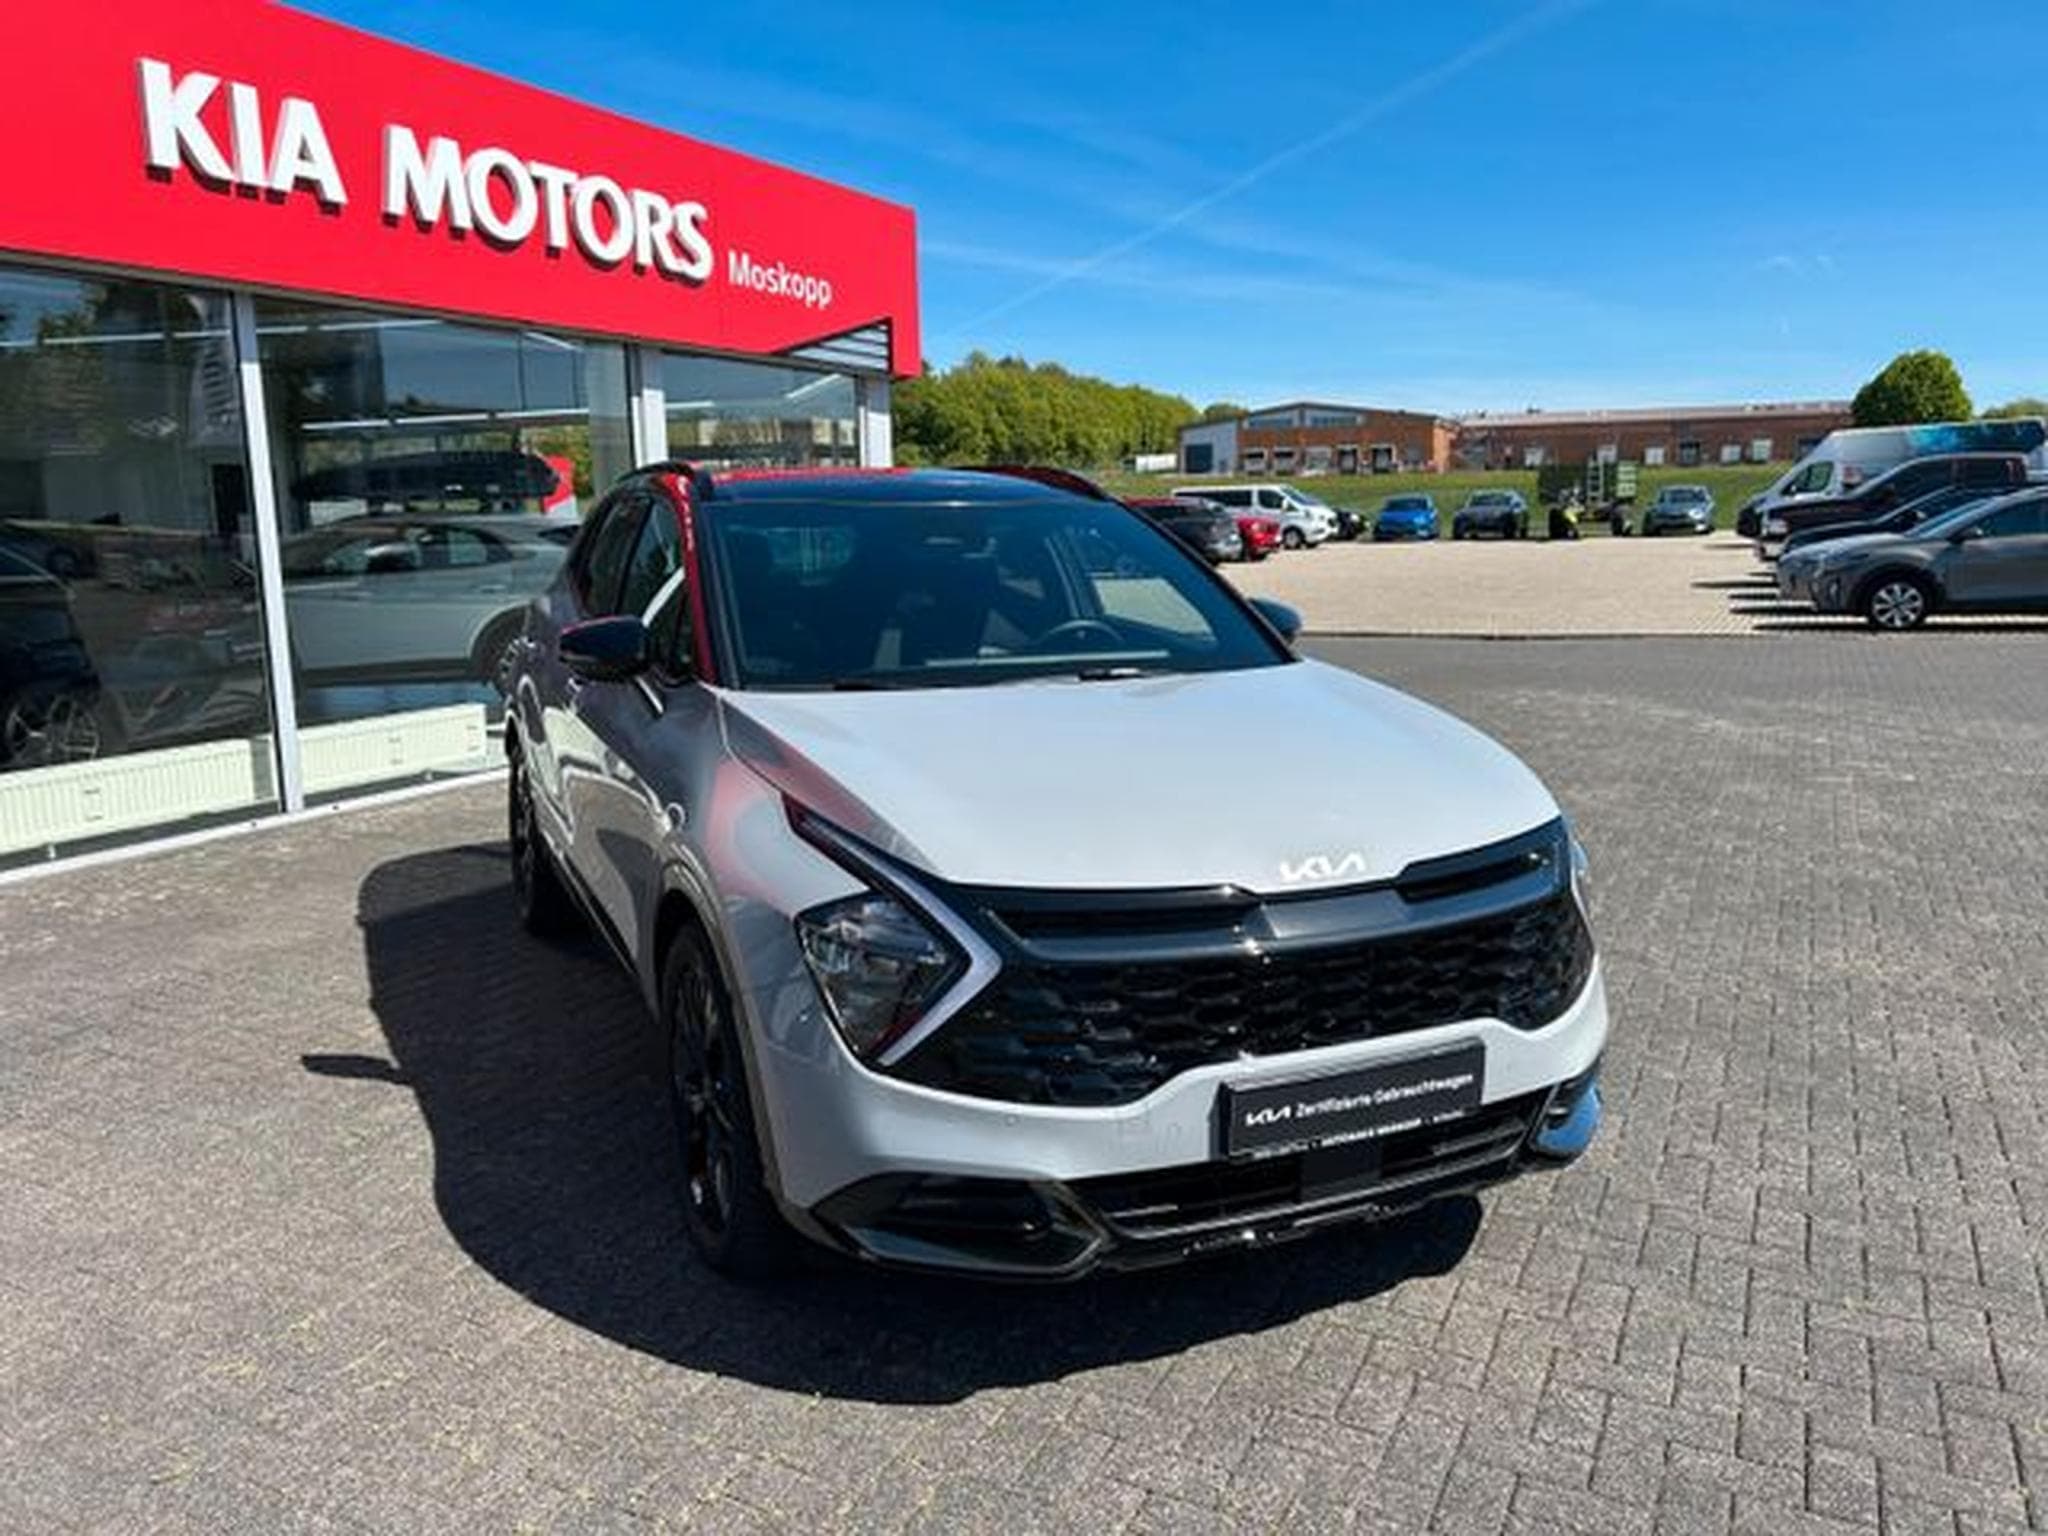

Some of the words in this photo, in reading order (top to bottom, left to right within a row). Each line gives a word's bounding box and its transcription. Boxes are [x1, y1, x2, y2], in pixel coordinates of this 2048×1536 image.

[138, 57, 348, 212] KIA
[383, 123, 713, 284] MOTORS
[728, 250, 832, 310] Moskopp
[1279, 852, 1366, 882] KIA
[1245, 1105, 1291, 1126] KIA
